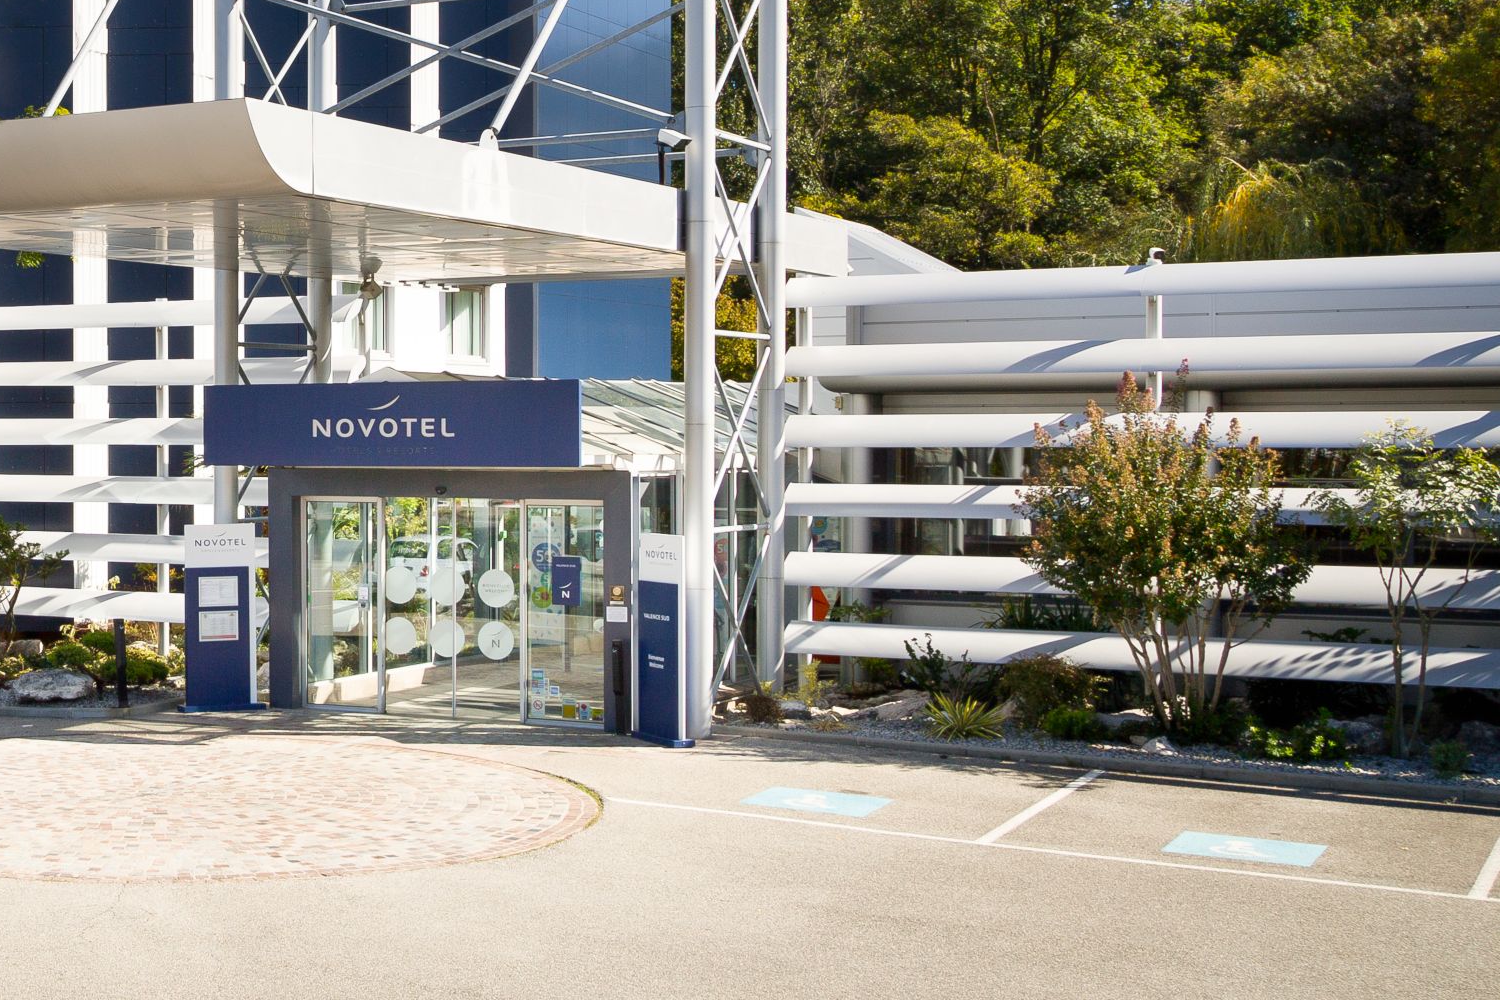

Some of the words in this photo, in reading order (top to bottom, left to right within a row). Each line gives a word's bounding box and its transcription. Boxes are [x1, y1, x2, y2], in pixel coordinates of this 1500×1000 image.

[312, 417, 455, 438] NOVOTEL
[194, 538, 247, 547] NOVOTEL
[645, 550, 677, 560] NOVOTEL
[561, 590, 571, 599] N
[661, 614, 670, 622] SUD
[491, 639, 500, 648] N
